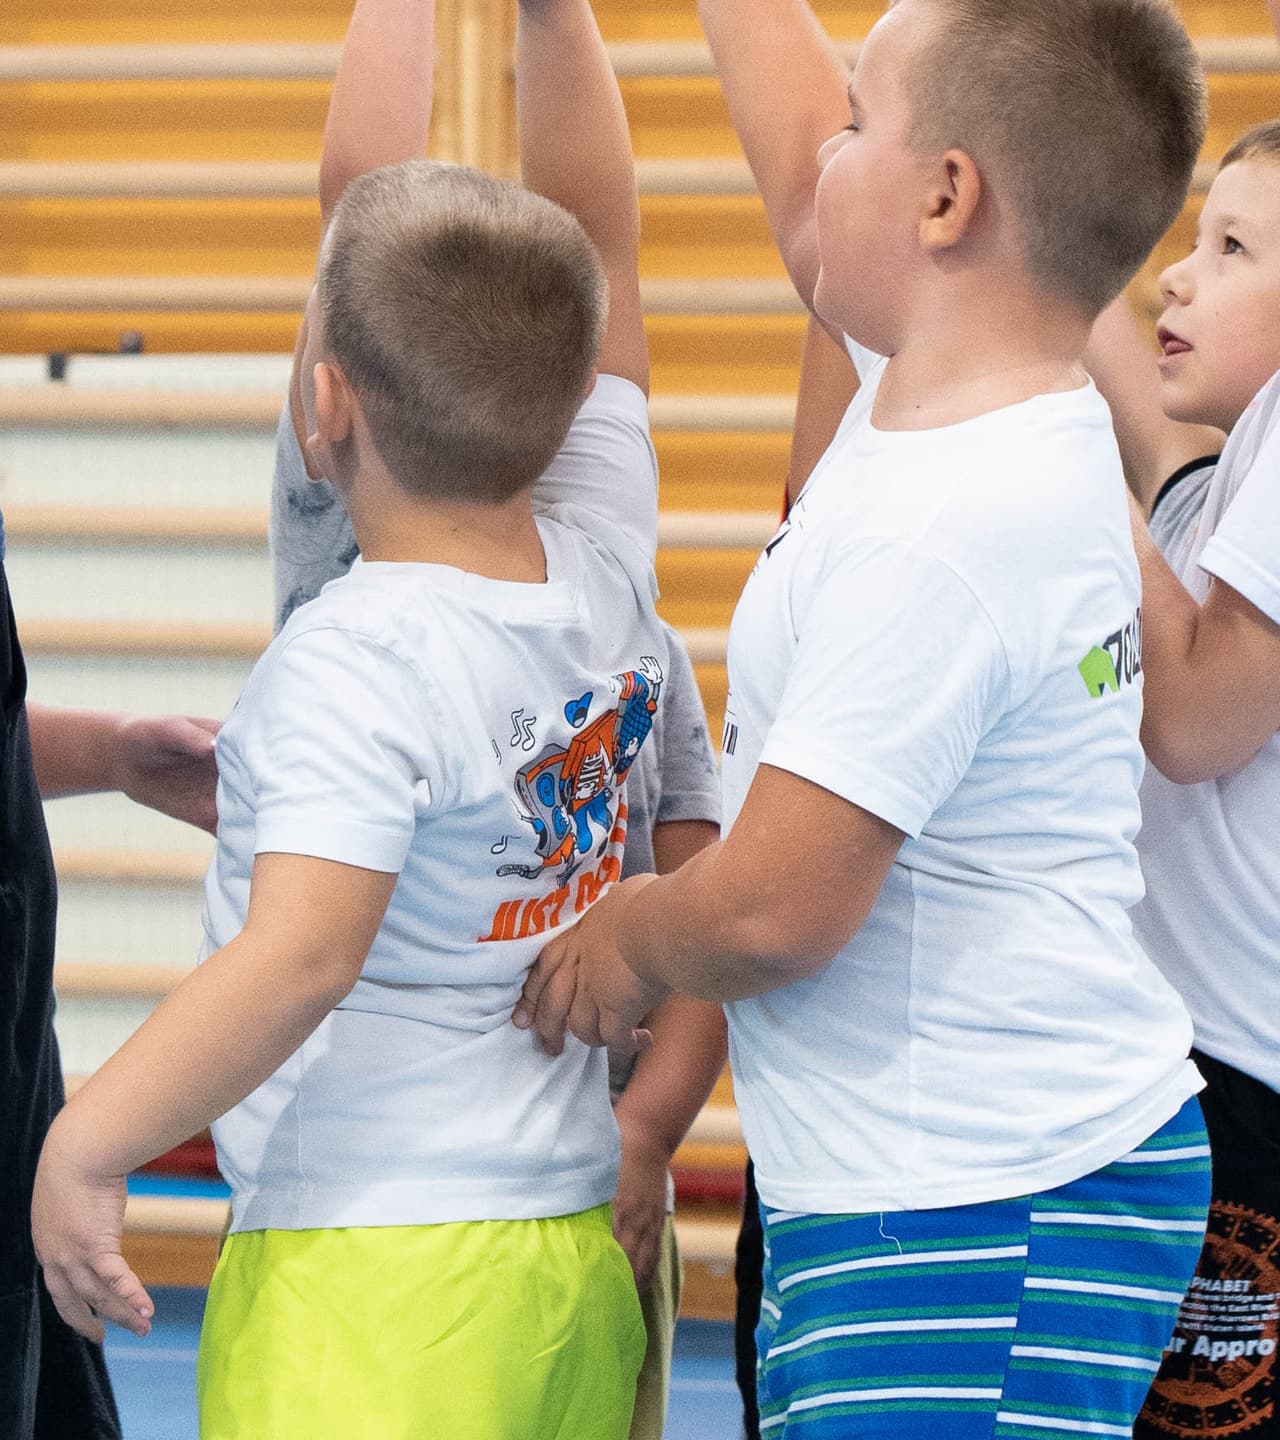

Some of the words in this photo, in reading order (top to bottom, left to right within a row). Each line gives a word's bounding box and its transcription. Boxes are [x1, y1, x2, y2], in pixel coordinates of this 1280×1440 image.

[477, 883, 570, 943] JUST
[1190, 1276, 1252, 1293] PHABET
[1190, 1334, 1278, 1362] Appro
